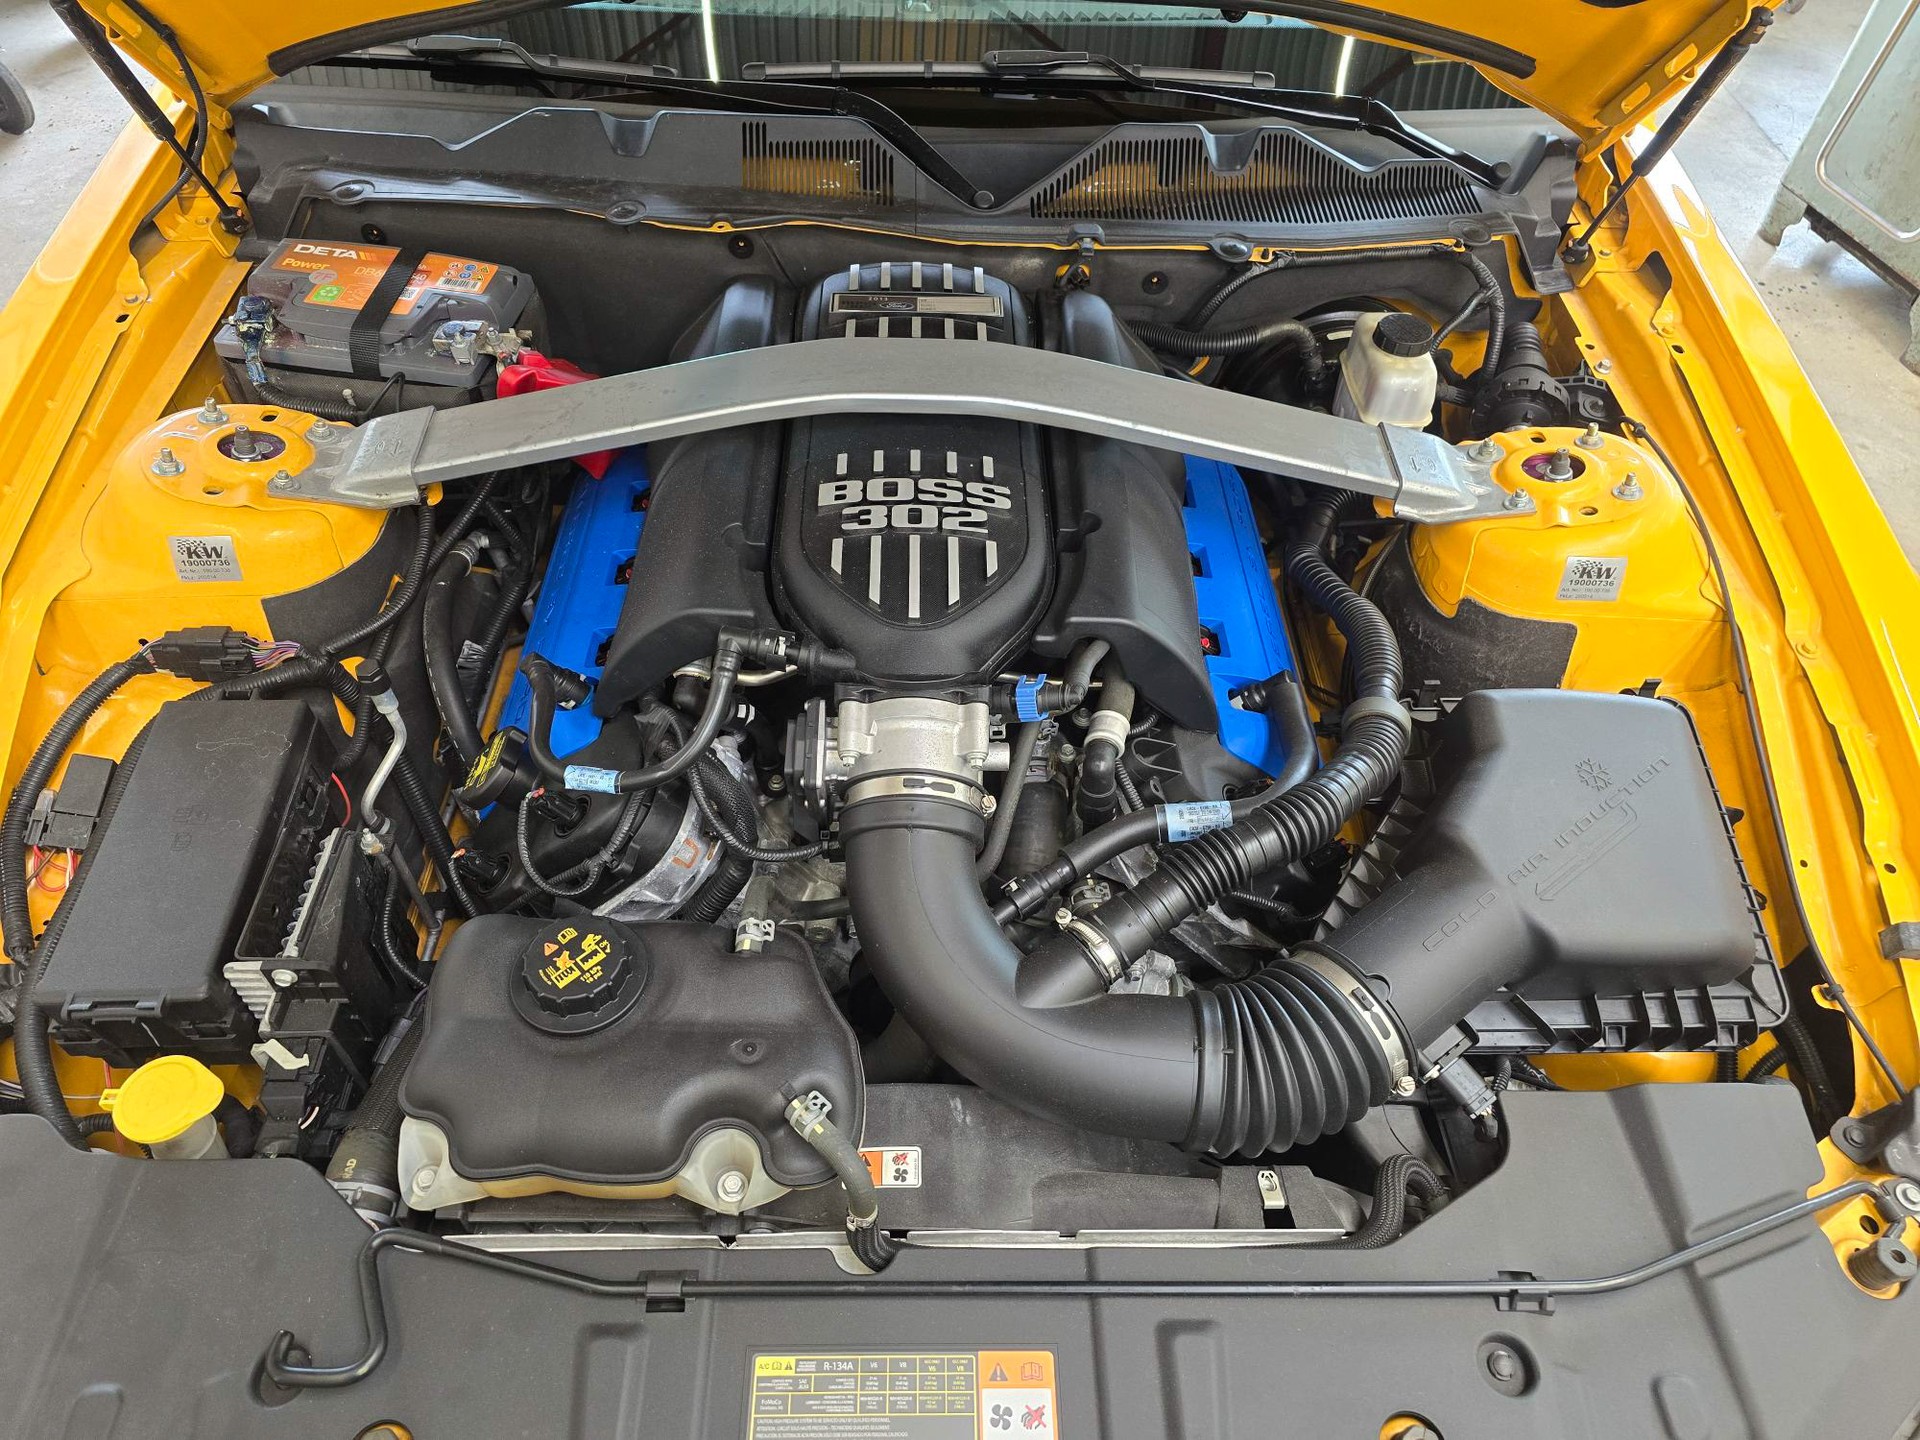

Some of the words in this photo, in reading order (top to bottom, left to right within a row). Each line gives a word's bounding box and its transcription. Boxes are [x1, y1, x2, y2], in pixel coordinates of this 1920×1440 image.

[293, 243, 358, 260] DETA
[281, 258, 331, 270] Power
[817, 477, 1012, 510] BOSS
[841, 504, 989, 534] 302
[1421, 889, 1498, 952] COLD
[1507, 851, 1550, 886] AIR
[1553, 754, 1672, 849] INDUCTION
[758, 1362, 770, 1370] A/C
[823, 1361, 854, 1371] R-134A
[869, 1361, 879, 1369] V6
[898, 1361, 908, 1369] V8
